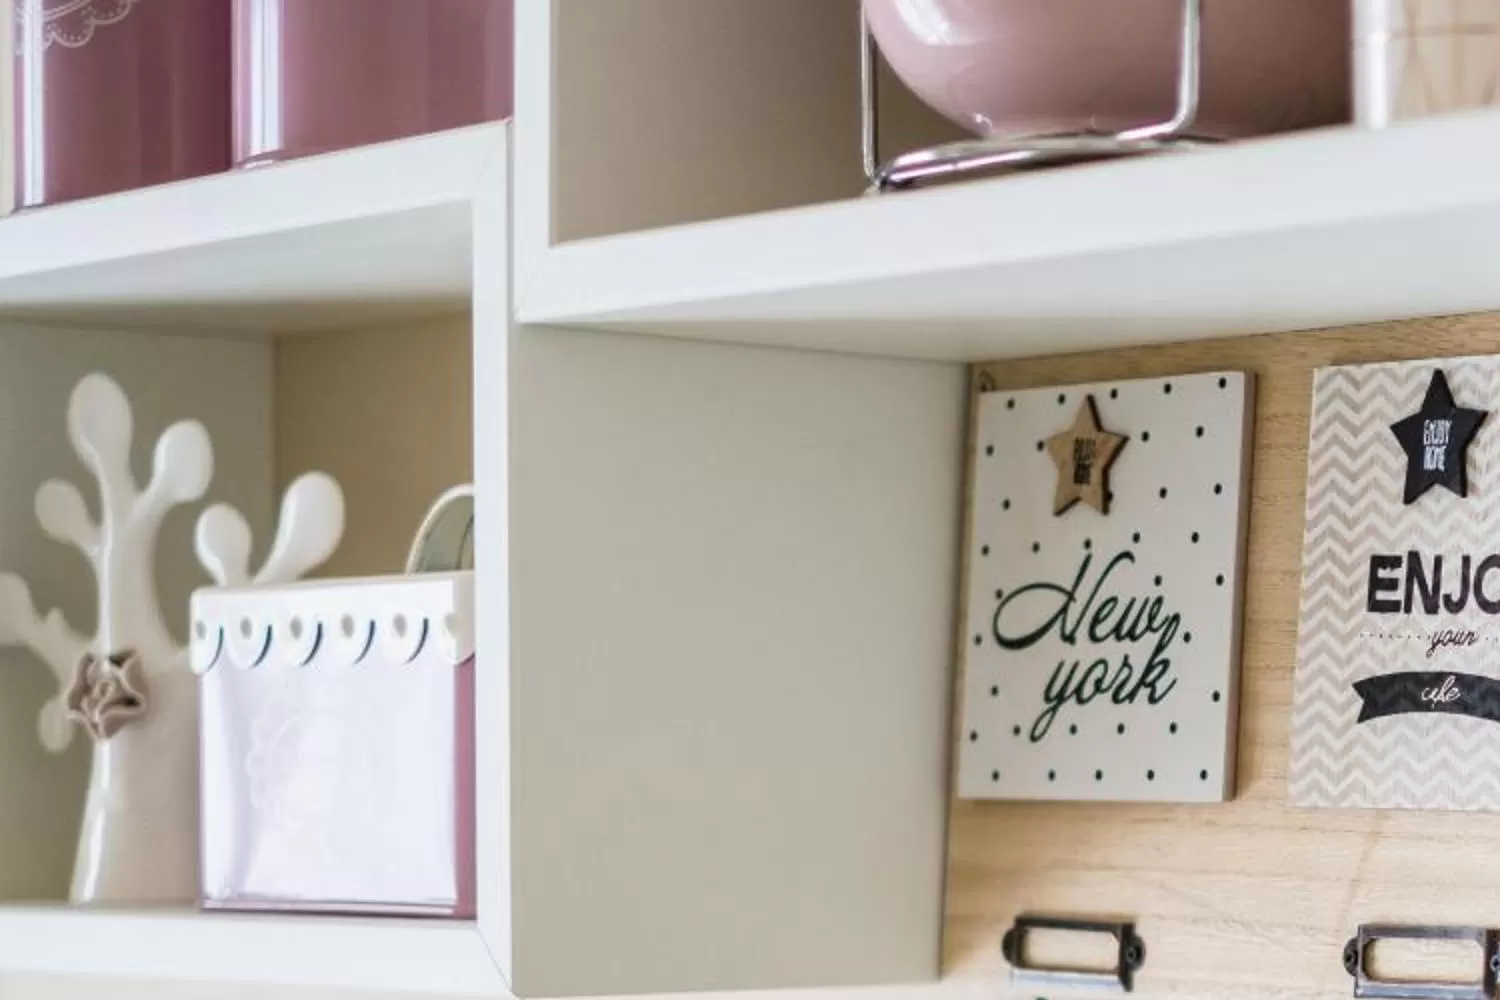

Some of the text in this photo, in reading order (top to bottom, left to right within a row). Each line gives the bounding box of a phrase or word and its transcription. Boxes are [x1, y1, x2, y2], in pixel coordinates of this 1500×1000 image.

[992, 550, 1170, 650] New
[1426, 629, 1478, 658] your
[1029, 612, 1181, 743] york
